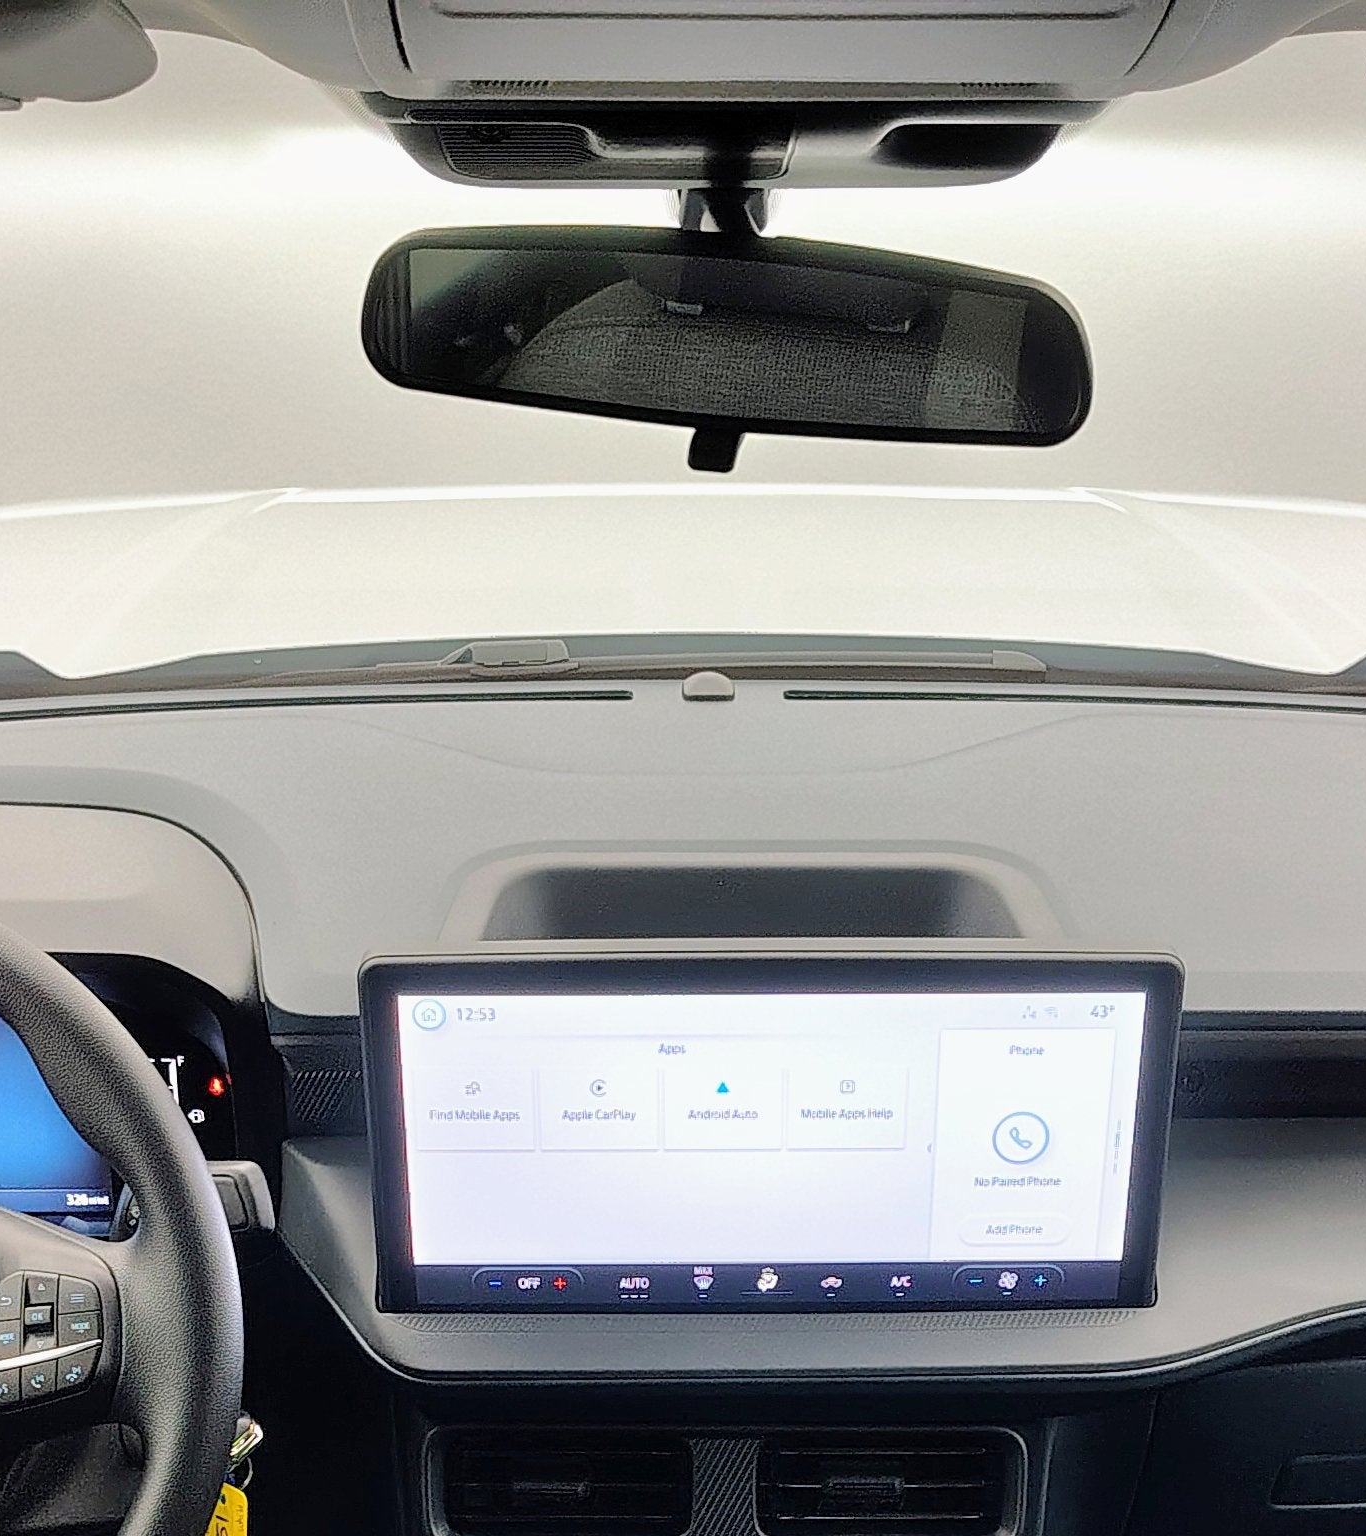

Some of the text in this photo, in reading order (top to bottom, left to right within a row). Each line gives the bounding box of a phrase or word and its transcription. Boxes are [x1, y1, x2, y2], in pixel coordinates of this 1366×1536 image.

[456, 1007, 497, 1022] 12:53
[658, 1043, 686, 1055] Apps
[1009, 1044, 1045, 1056] Phone
[176, 1055, 185, 1067] F
[428, 1109, 521, 1122] Find Mobile Apps
[562, 1109, 637, 1121] Apple CarPlay
[688, 1108, 758, 1120] Android Auto
[800, 1107, 894, 1120] Mobile Apps Help
[973, 1176, 1062, 1187] No Paired Phone
[985, 1224, 1044, 1235] Add Phone
[517, 1276, 541, 1289] OFF
[619, 1276, 650, 1290] AUTO
[889, 1275, 913, 1288] A/C
[31, 1312, 44, 1321] OK
